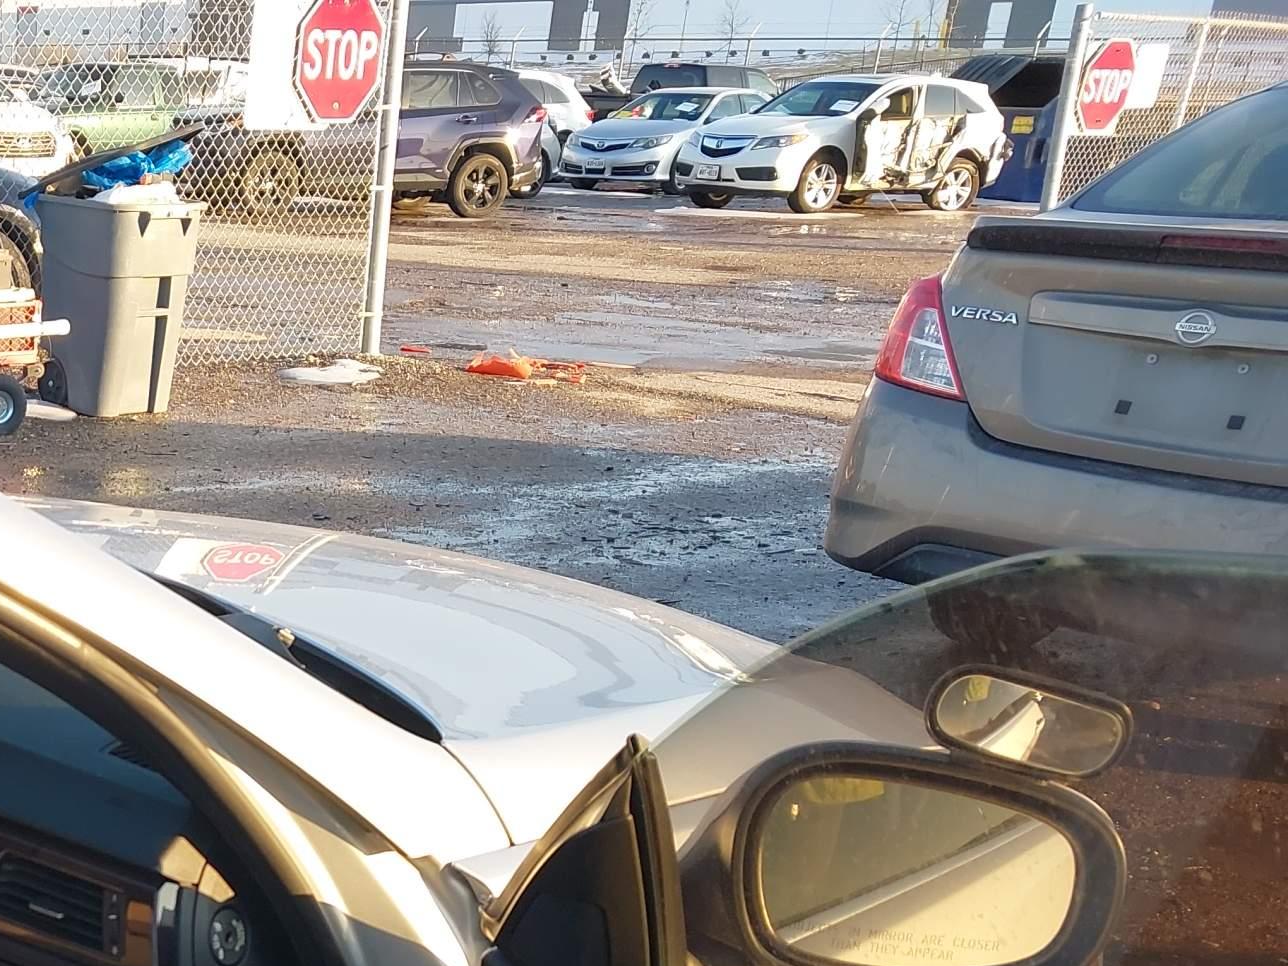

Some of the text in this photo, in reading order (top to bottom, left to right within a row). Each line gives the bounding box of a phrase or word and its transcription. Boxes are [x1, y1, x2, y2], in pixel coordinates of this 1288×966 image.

[303, 28, 378, 80] STOP
[1084, 69, 1132, 104] STOP
[951, 305, 1018, 325] VERSA
[1178, 323, 1212, 333] NISSAN
[831, 940, 953, 961] THAN THEY APPEAR
[868, 929, 913, 943] MIRROR
[921, 933, 944, 946] ARE
[952, 936, 1000, 952] CLOSER
